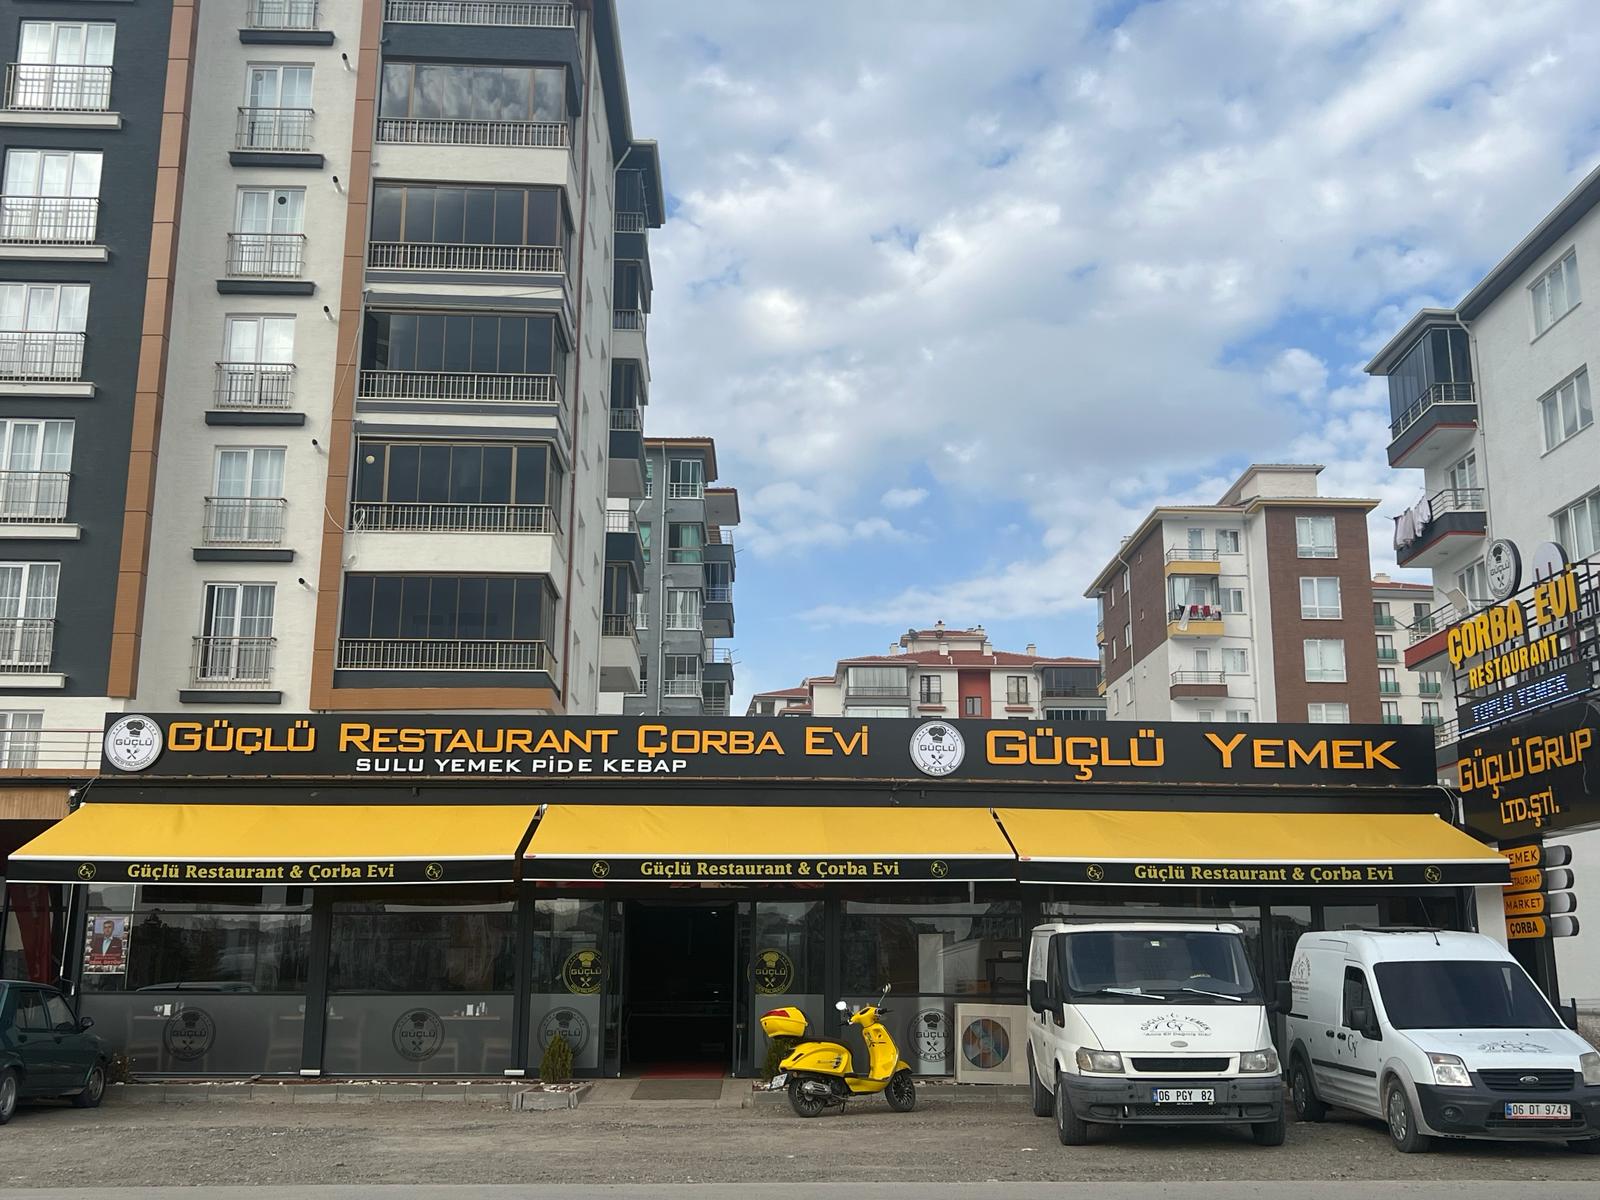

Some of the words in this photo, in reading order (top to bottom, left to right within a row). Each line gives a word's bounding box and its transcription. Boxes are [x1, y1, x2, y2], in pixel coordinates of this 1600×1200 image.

[1447, 599, 1525, 671] ÇORBA
[1468, 633, 1559, 691] RESTAURANT
[167, 719, 316, 755] GÜÇLÜ
[986, 727, 1165, 781] GÜÇLÜ
[1204, 733, 1401, 769] YEMEK
[355, 758, 424, 773] SULU
[434, 758, 522, 773] YEMEK
[532, 755, 593, 773] PİDE
[603, 759, 687, 773] KEBAP
[1457, 736, 1525, 800] GÜÇLÜ
[1525, 728, 1592, 775] GRUP
[127, 863, 180, 881] Güçlü
[185, 864, 284, 879] Restaurant
[289, 864, 304, 879] &
[308, 863, 362, 882] Çorba
[366, 863, 395, 878] Evi
[640, 860, 692, 877] Güçlü
[696, 862, 793, 876] Restaurant
[797, 861, 810, 876] &
[816, 860, 868, 878] Çorba
[872, 861, 900, 876] Evi
[1134, 864, 1185, 882] Güçlü
[1190, 866, 1287, 881] Restaurant
[1291, 866, 1305, 881] &
[1310, 866, 1362, 883] Çorba
[1366, 866, 1394, 881] Evi
[1505, 898, 1541, 911] MARKET
[1510, 921, 1539, 937] ÇORBA
[1158, 1090, 1170, 1101] 06
[1176, 1090, 1193, 1101] PGY
[1201, 1090, 1213, 1101] 82
[1512, 1104, 1525, 1115] 06
[1545, 1104, 1569, 1115] 9743
